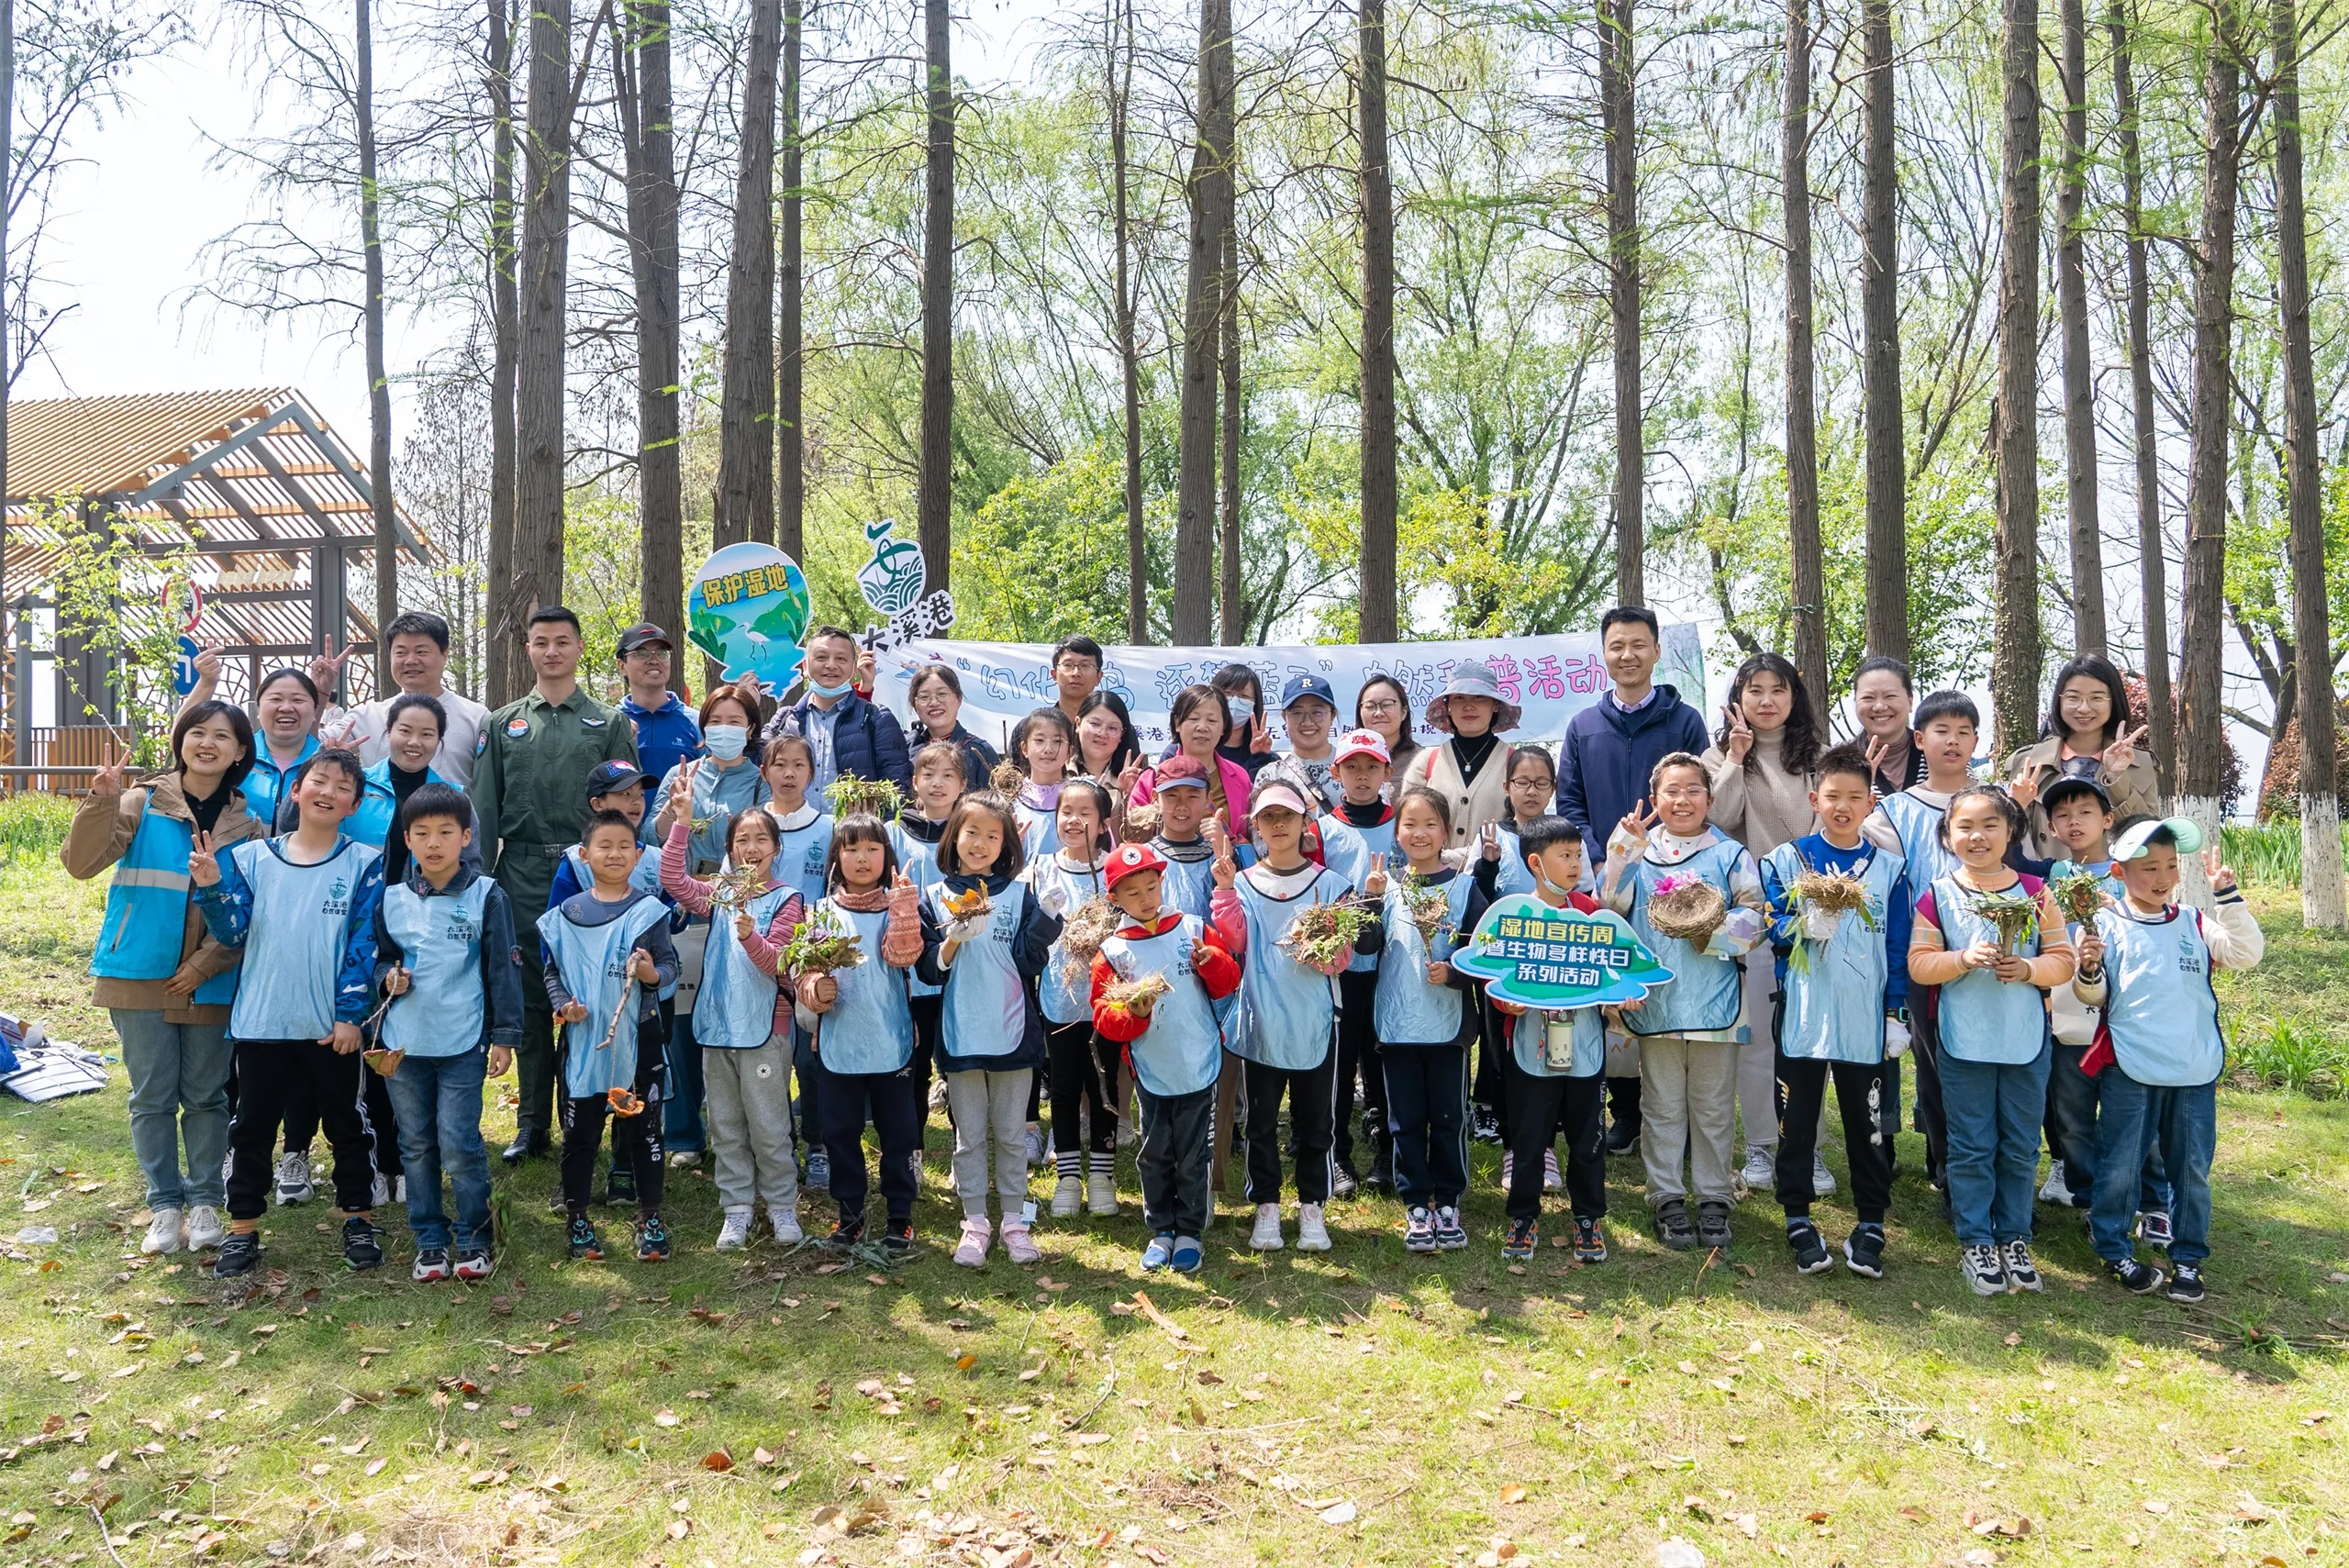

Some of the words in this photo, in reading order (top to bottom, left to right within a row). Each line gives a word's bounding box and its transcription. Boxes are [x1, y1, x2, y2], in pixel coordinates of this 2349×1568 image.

[702, 562, 789, 608] 保护湿地
[862, 594, 954, 652] 大溪港
[1301, 678, 1313, 688] R
[1499, 917, 1614, 945] 湿地宣传周
[1486, 940, 1630, 967] 暨生物多样性日
[1518, 964, 1599, 986] 系列活动
